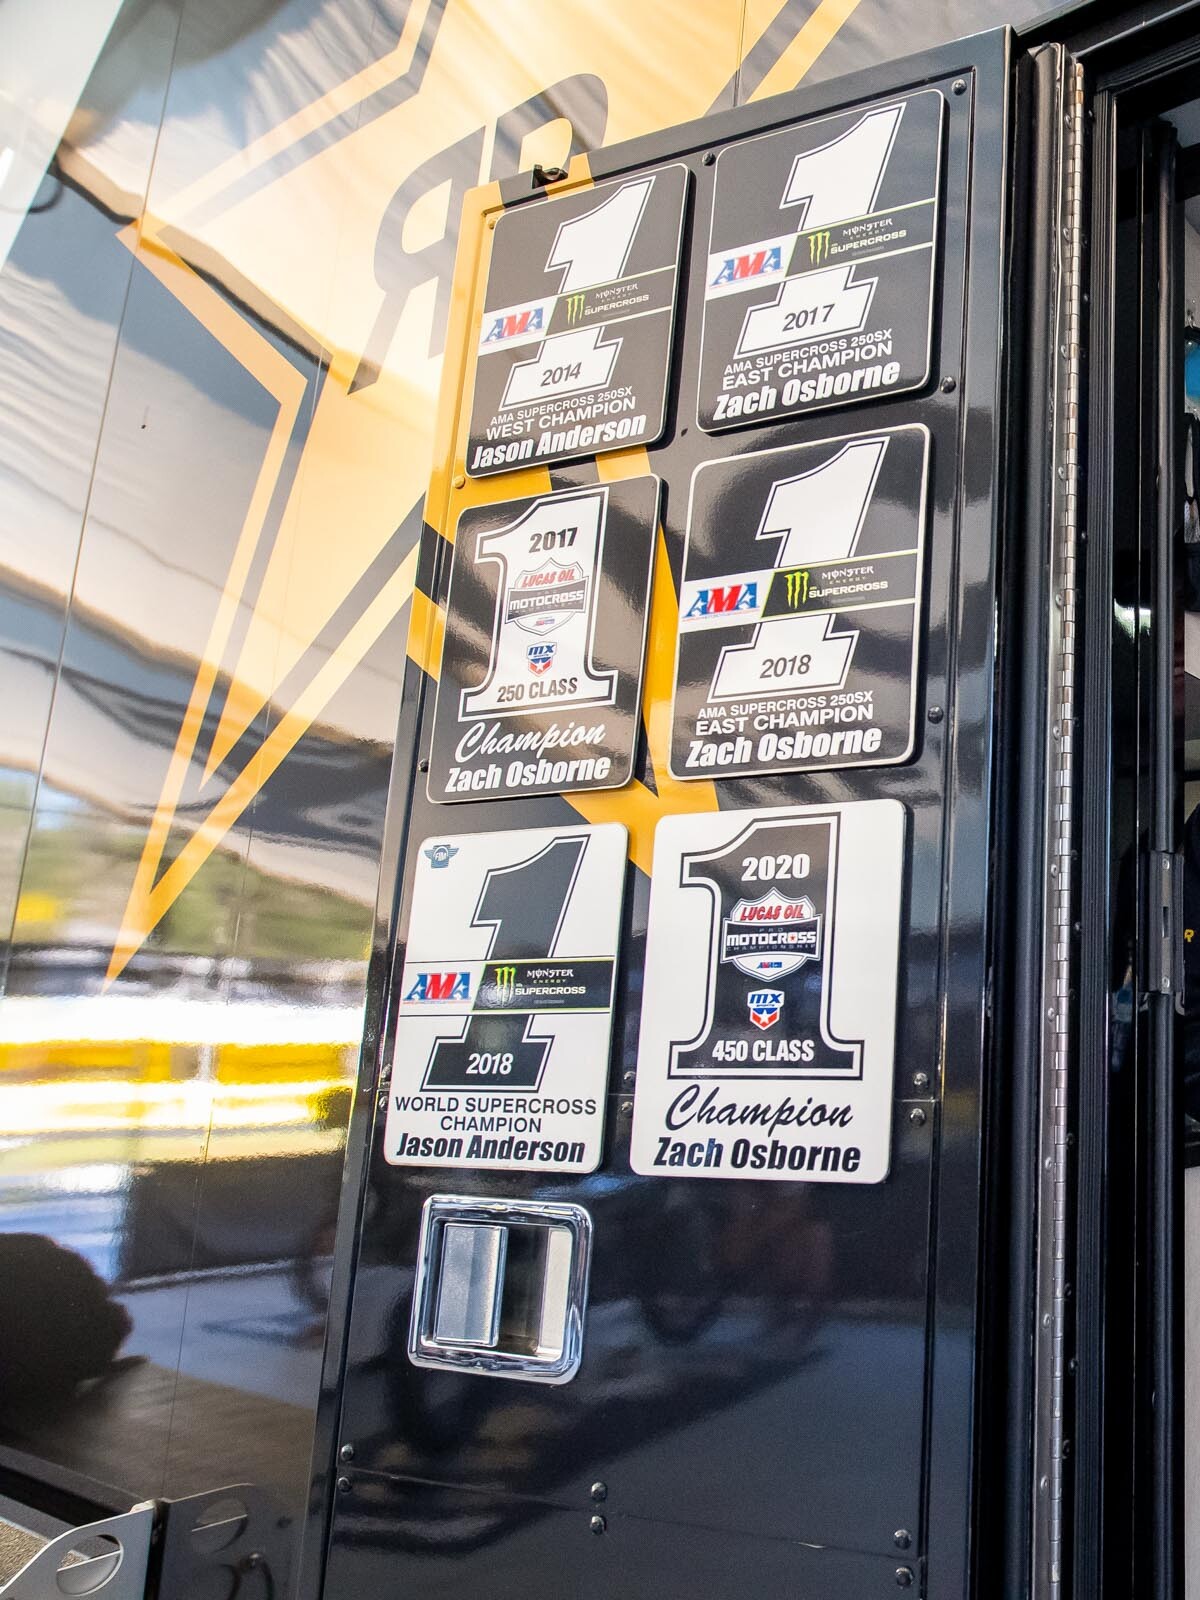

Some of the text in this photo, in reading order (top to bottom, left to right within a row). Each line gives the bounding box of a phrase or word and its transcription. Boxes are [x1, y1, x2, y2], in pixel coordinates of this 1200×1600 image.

[843, 218, 893, 237] MONSTER
[830, 230, 907, 254] SUPERCROSS
[710, 246, 781, 286] AMA
[584, 295, 649, 316] SUPERCROSS
[782, 303, 835, 332] 2017
[482, 307, 543, 343] AMA
[723, 341, 892, 390] EAST CHAMPION
[724, 328, 892, 375] AMA SUPERCROSS 250SX
[540, 362, 582, 387] 2014
[712, 361, 900, 421] Zach Osborne
[486, 396, 636, 440] WEST CHAMPION
[490, 386, 633, 426] AMA SUPERCROSS 250SX
[471, 414, 647, 469] Jason Anderson
[529, 527, 578, 553] 2017
[522, 569, 575, 588] LUCAS OIL
[822, 566, 874, 580] MONSTER
[510, 590, 584, 610] MOTOCROSS
[686, 582, 757, 618] AMA
[809, 581, 888, 599] SUPERCROSS
[760, 654, 811, 679] 2018
[497, 677, 578, 702] 250 CLASS
[698, 691, 873, 719] AMA SUPERCROSS 250SX
[696, 704, 873, 735] EAST CHAMPION
[455, 722, 606, 763] Champion
[685, 727, 882, 767] Zach Osborne
[445, 757, 611, 792] Zach Osborne
[741, 853, 810, 881] 2020
[740, 905, 804, 921] LUCAS OIL
[727, 931, 816, 946] MOTOCROSS
[406, 972, 470, 1000] AMA
[527, 969, 574, 978] MONSTER
[515, 986, 586, 996] SUPERCROSS
[466, 1053, 513, 1075] 2018
[712, 1040, 815, 1061] 450 CLASS
[396, 1097, 596, 1115] WORLD SUPERCROSS
[665, 1084, 853, 1137] Champion
[441, 1116, 541, 1132] CHAMPION
[396, 1133, 585, 1163] Jason Anderson
[653, 1137, 861, 1172] Zach Osborne
